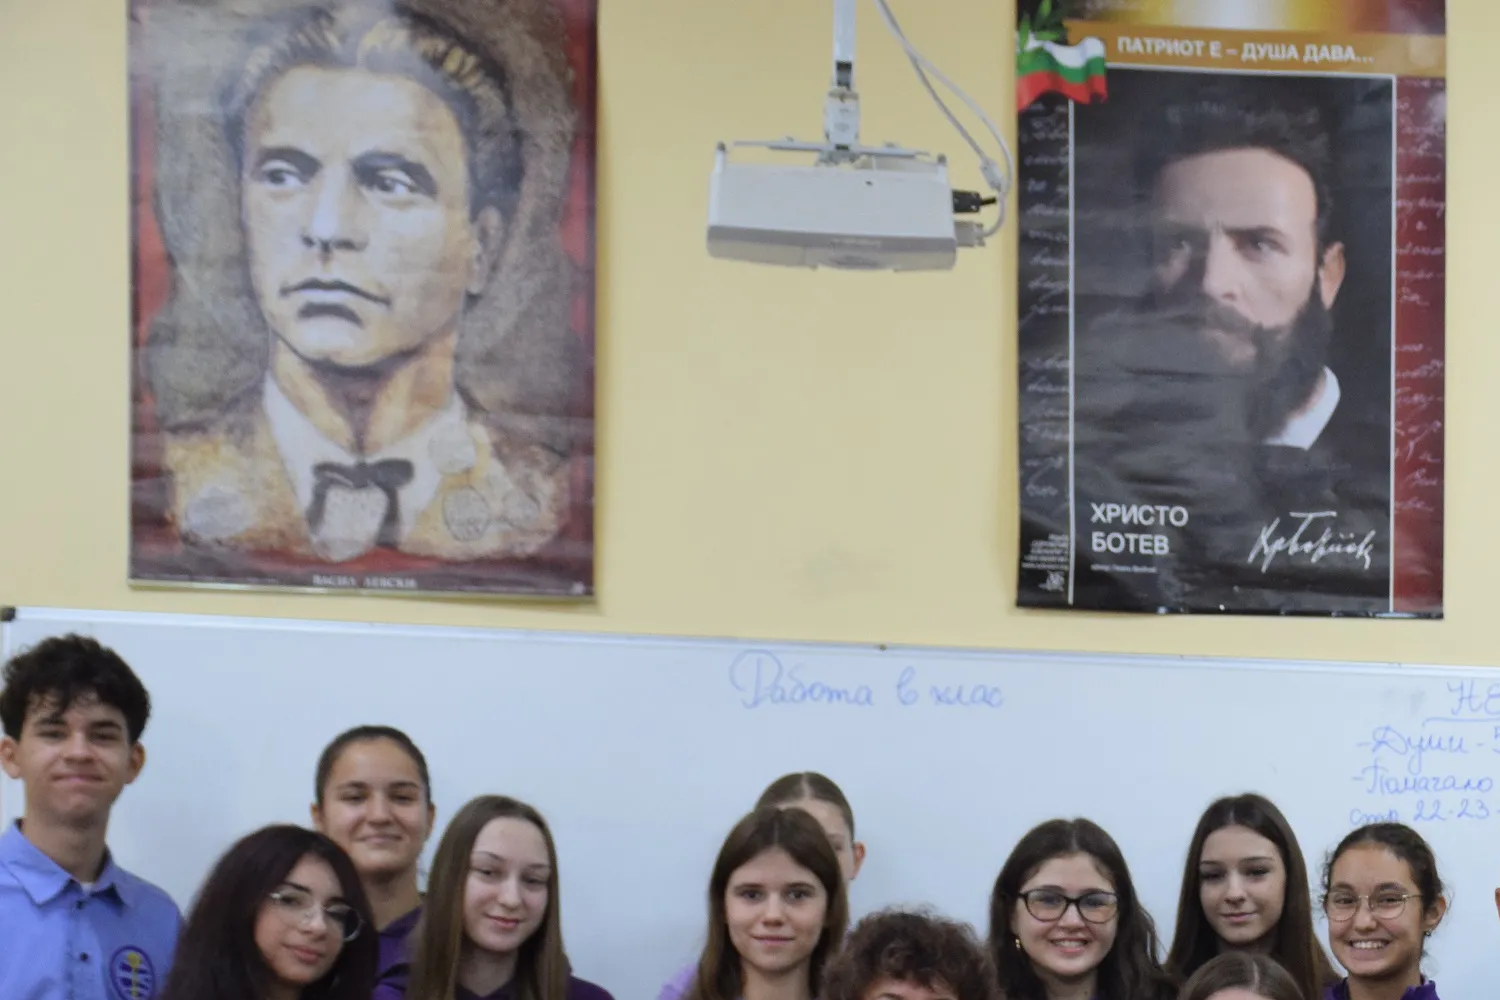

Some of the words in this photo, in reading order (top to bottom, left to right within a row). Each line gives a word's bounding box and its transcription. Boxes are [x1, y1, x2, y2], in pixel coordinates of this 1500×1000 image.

[1117, 36, 1205, 57] ПАТРИОТ
[1210, 40, 1222, 58] Е
[1241, 42, 1299, 61] ДУША
[1089, 502, 1189, 527] ХРИСТО
[1091, 531, 1170, 555] БОТЕВ
[728, 649, 873, 709] Работа
[896, 665, 919, 706] в
